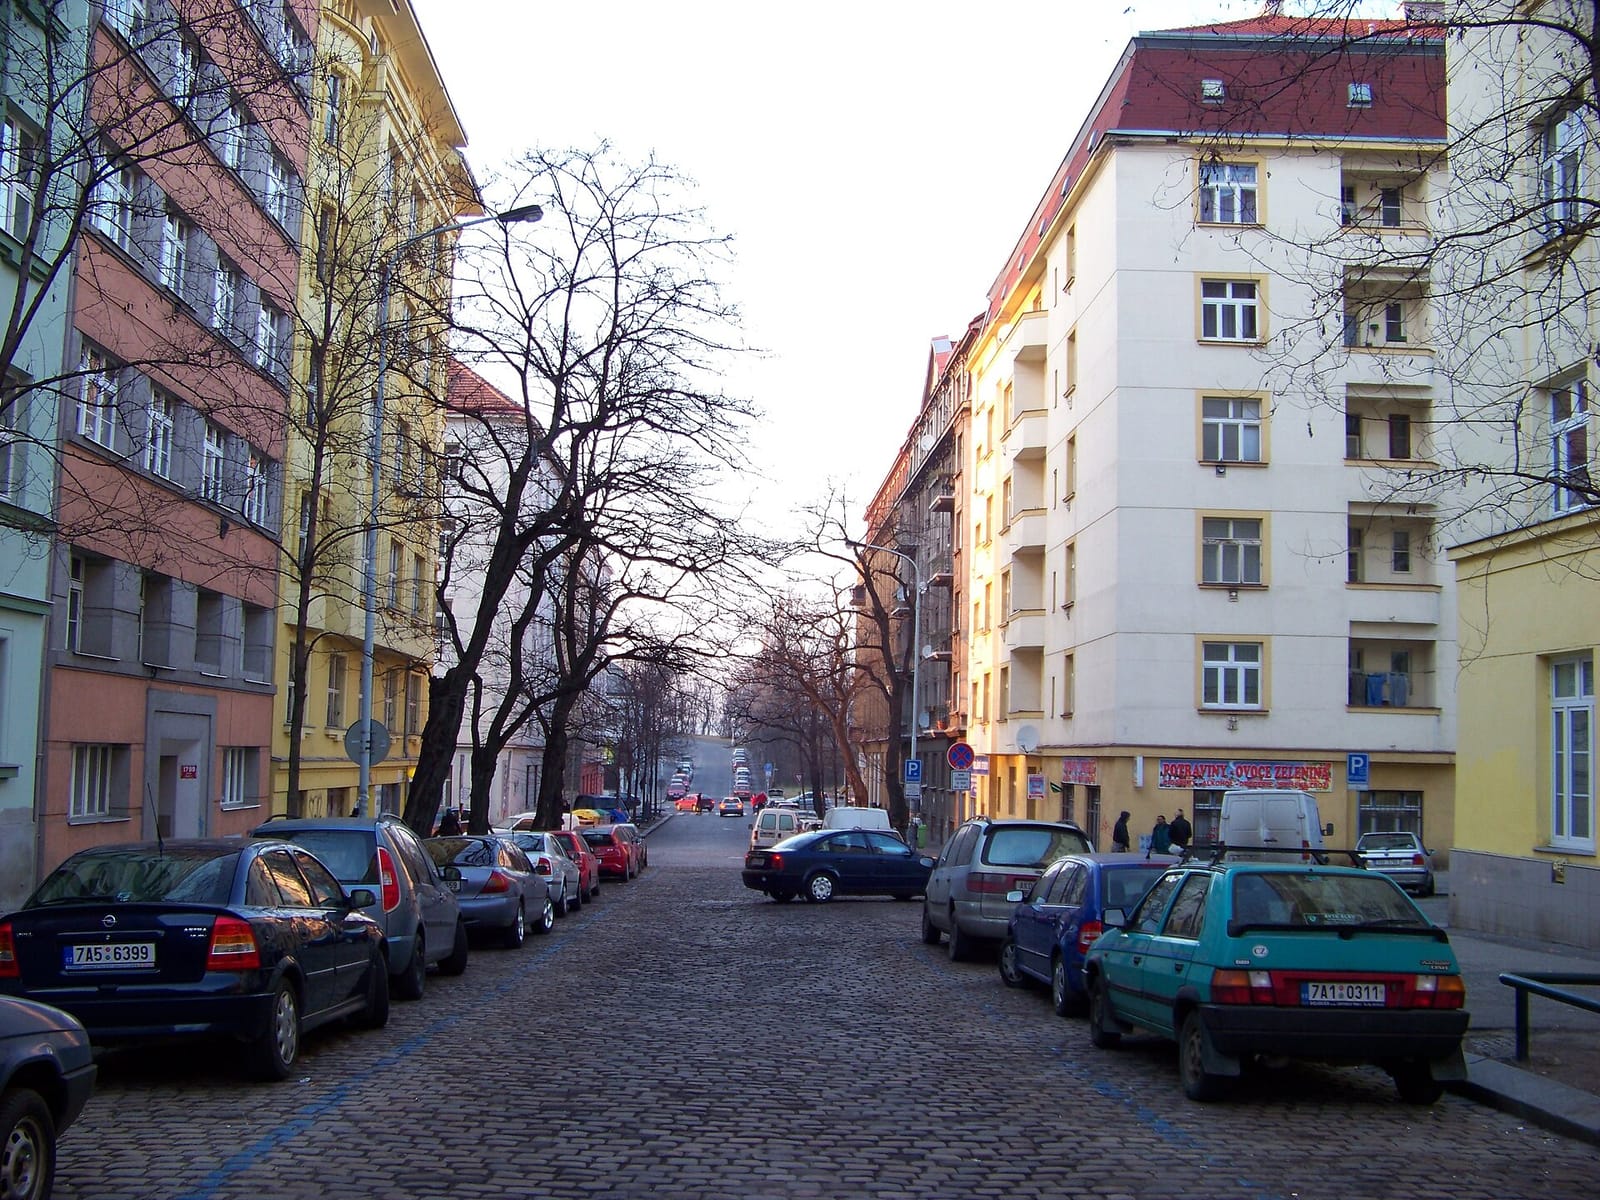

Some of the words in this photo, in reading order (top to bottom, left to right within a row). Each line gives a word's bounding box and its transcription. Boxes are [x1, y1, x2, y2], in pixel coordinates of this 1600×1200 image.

[908, 762, 918, 775] P
[1163, 763, 1228, 778] POTRAVINY
[1235, 765, 1271, 778] OVOCE
[1351, 756, 1364, 774] P
[75, 946, 103, 962] 7A5
[113, 945, 149, 961] 6399
[1311, 984, 1336, 999] 7A1
[1346, 984, 1379, 1000] 0311
